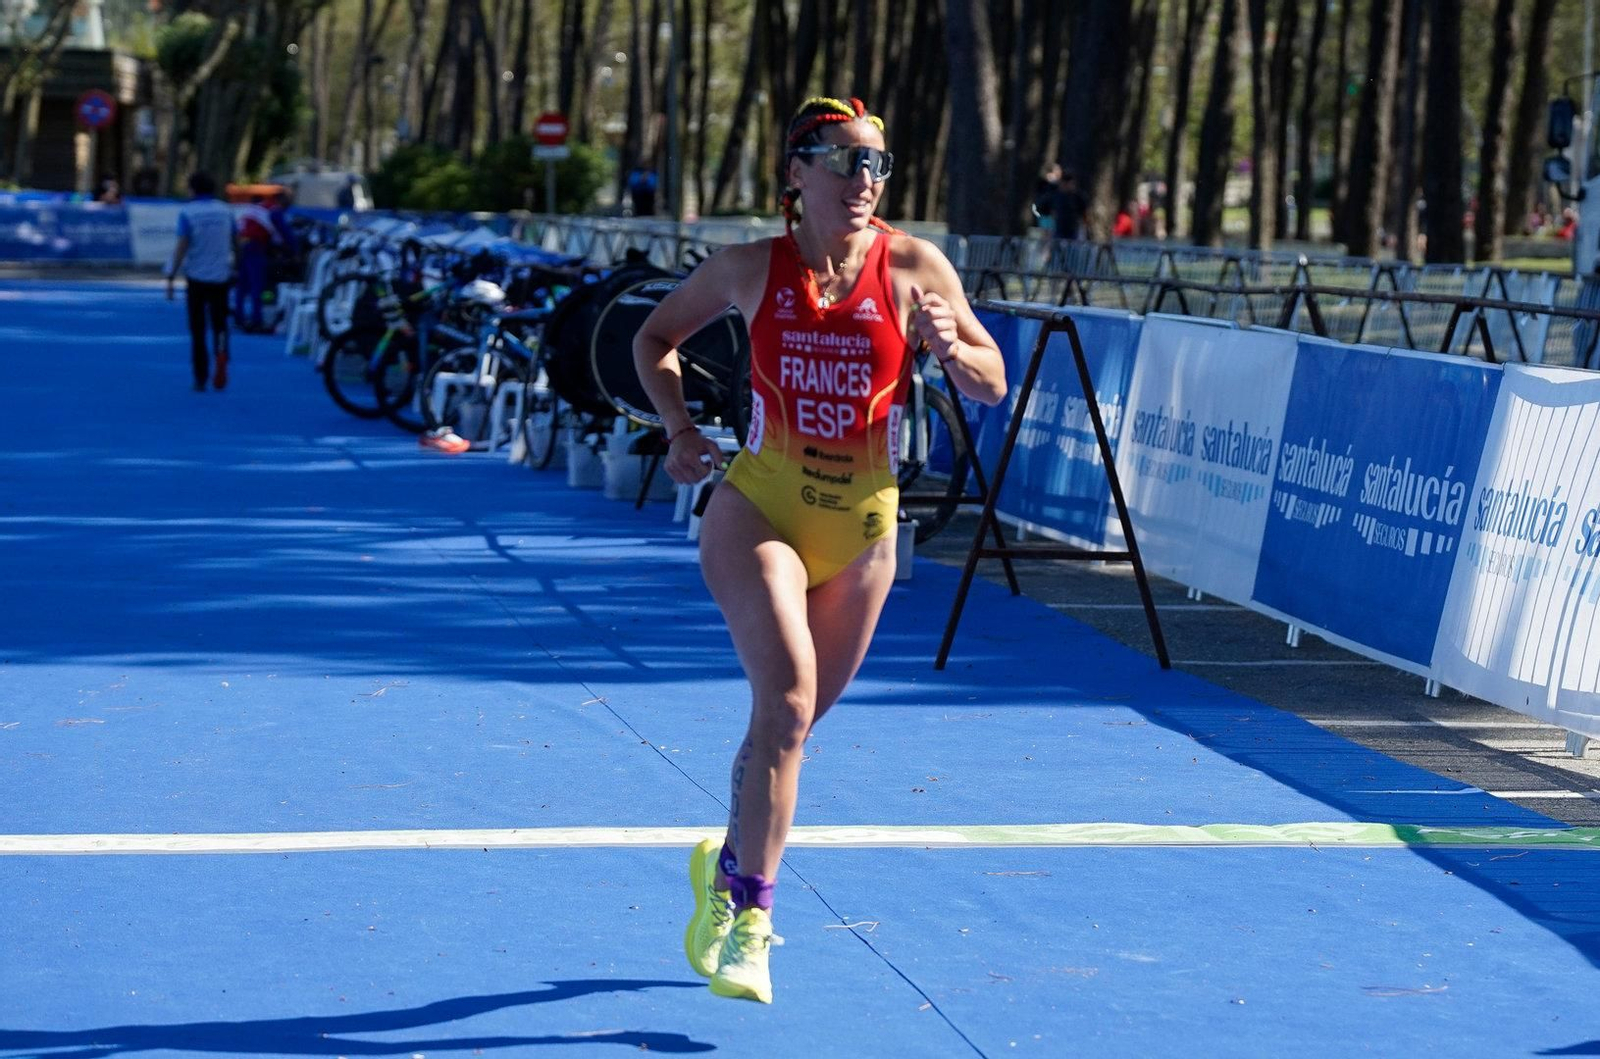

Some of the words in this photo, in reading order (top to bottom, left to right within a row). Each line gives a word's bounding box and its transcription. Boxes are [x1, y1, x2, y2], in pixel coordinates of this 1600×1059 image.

[780, 355, 873, 398] FRANCES
[797, 398, 856, 439] ESP
[1201, 419, 1273, 475] santalucía
[1278, 436, 1354, 498] santalucía
[1360, 455, 1466, 526] santalucía
[1474, 479, 1568, 548] santalucía
[1373, 521, 1406, 552] SEGUROS
